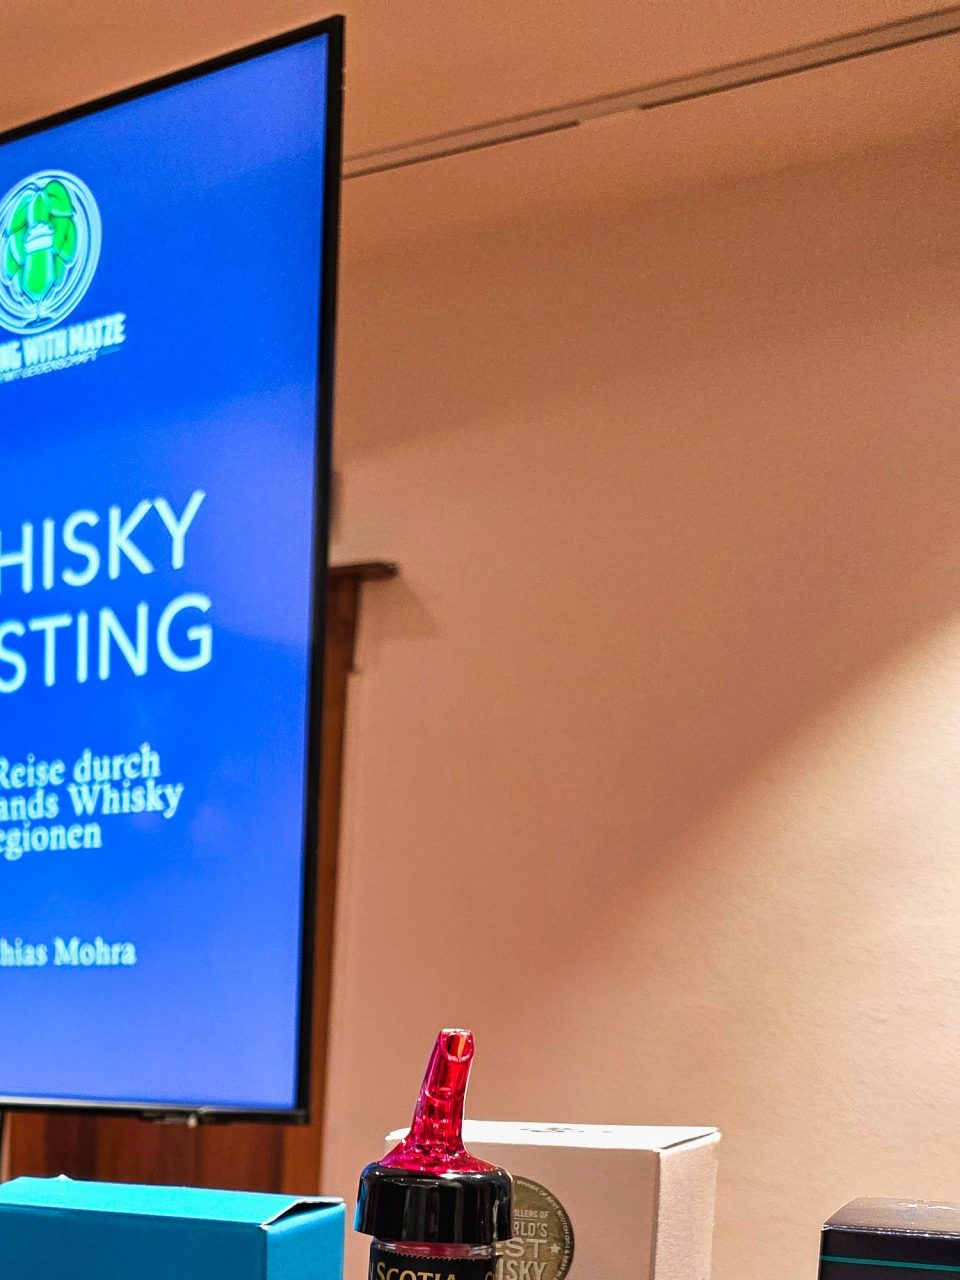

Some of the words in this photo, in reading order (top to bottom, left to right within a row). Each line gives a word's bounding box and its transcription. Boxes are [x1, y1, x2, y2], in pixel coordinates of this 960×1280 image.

[22, 329, 67, 367] WITH
[69, 312, 127, 354] MATZE
[73, 741, 161, 785] durch
[67, 778, 184, 819] Whisky
[53, 936, 137, 966] Mohra
[540, 1210, 549, 1219] OF
